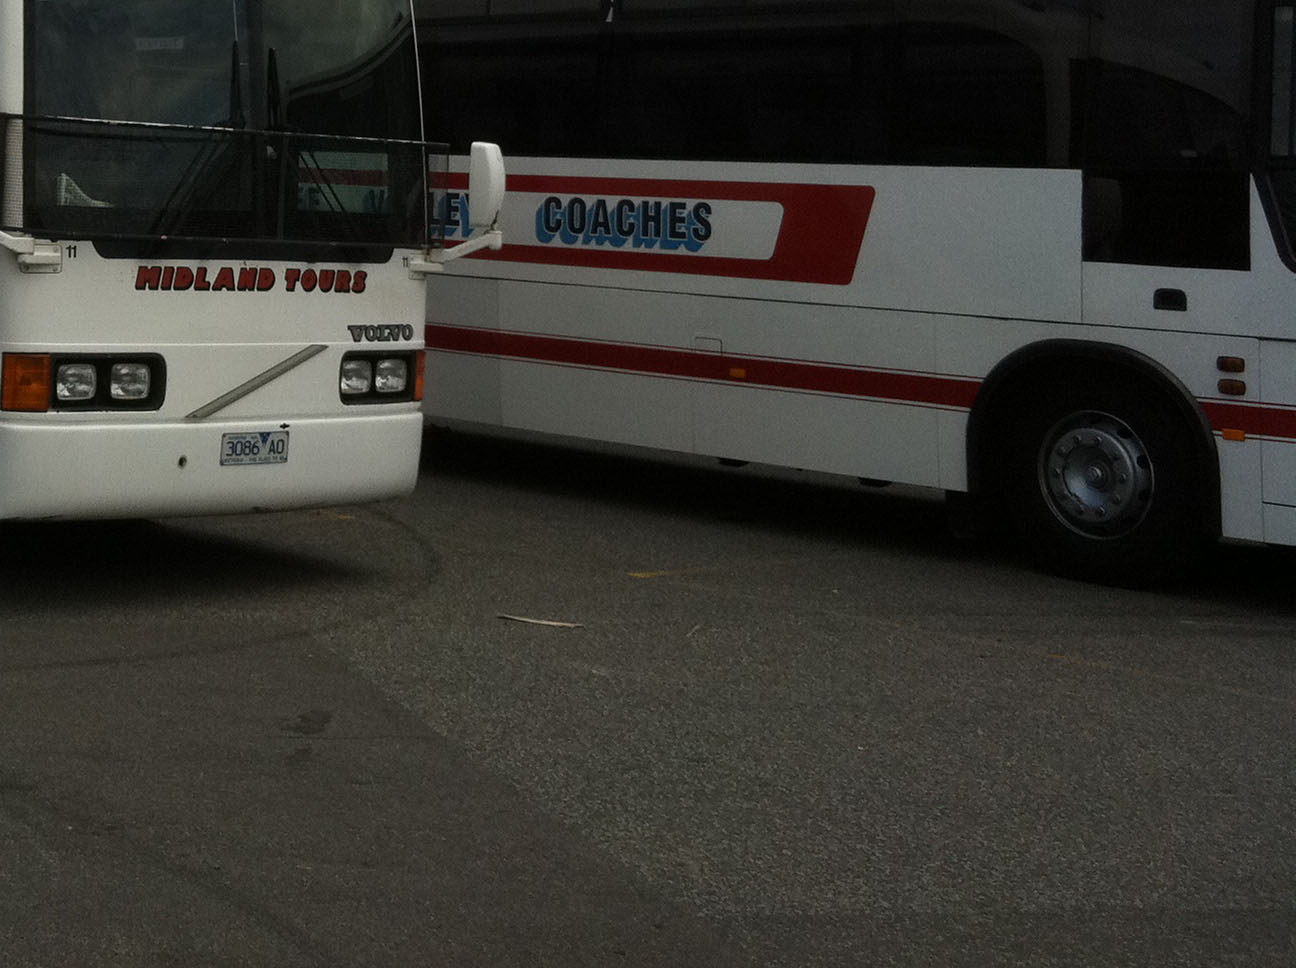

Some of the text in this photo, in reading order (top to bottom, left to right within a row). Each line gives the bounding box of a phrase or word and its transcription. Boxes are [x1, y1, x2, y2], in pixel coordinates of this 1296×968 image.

[536, 196, 712, 252] COACHES
[65, 244, 77, 258] 11
[135, 266, 367, 293] MIDLAND TOURS
[347, 324, 414, 342] VOLVO
[225, 440, 260, 456] 3086
